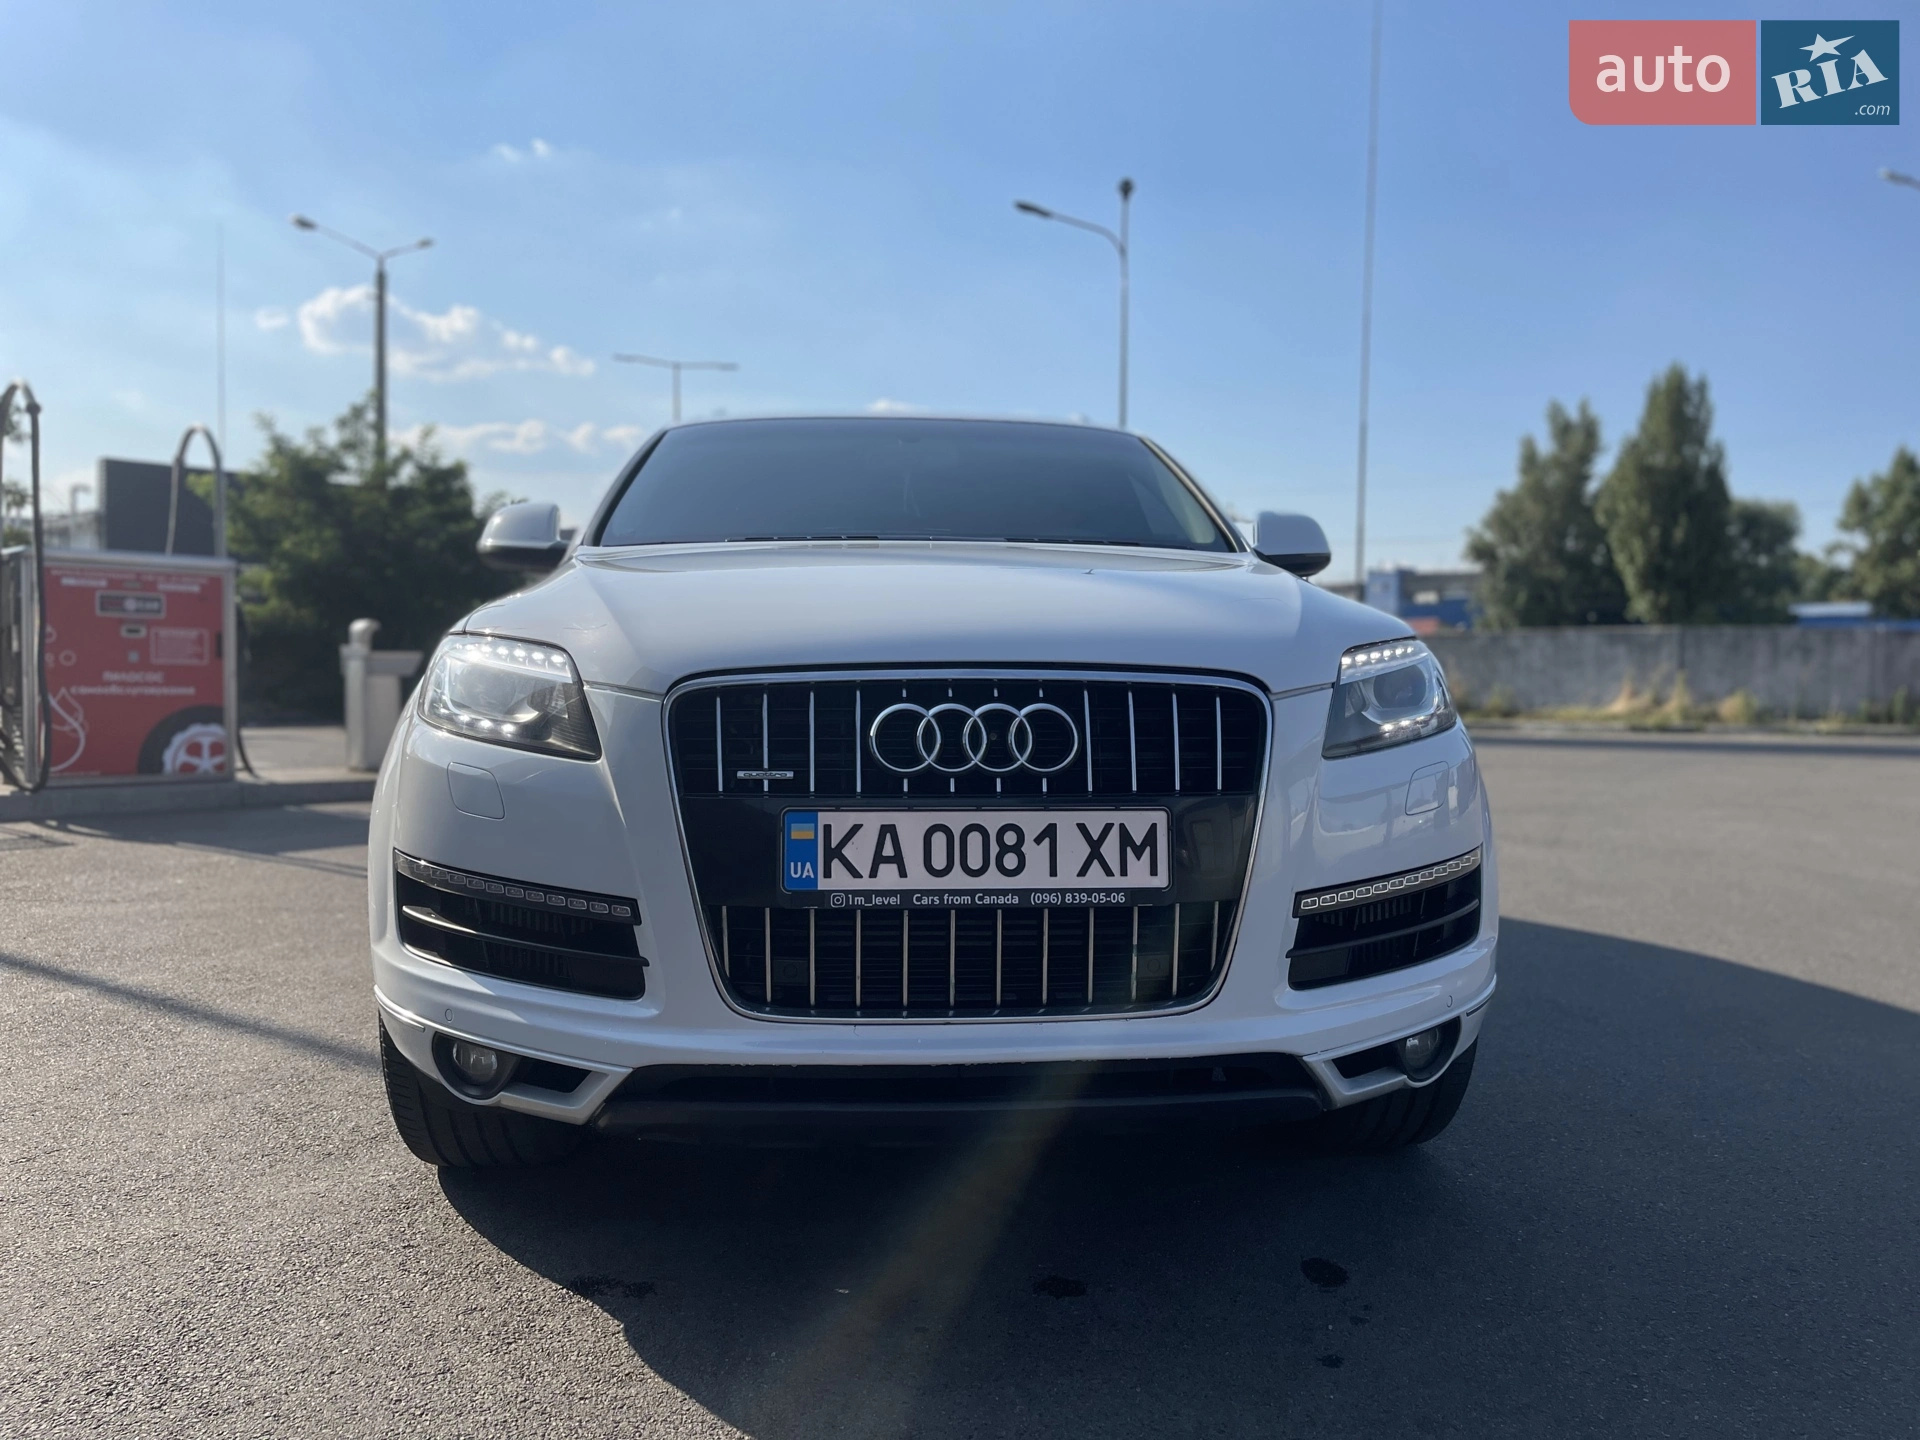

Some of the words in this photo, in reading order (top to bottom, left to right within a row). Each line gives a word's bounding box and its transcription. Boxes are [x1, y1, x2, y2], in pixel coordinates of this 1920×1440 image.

[822, 823, 908, 879] KA
[923, 823, 1058, 878] 0081
[1076, 822, 1159, 878] XM
[790, 862, 814, 879] UA
[912, 893, 940, 905] Cars
[943, 893, 971, 905] from
[975, 893, 1019, 904] Canada
[1030, 892, 1062, 905] (096)
[1065, 892, 1126, 904] 839-05-06
